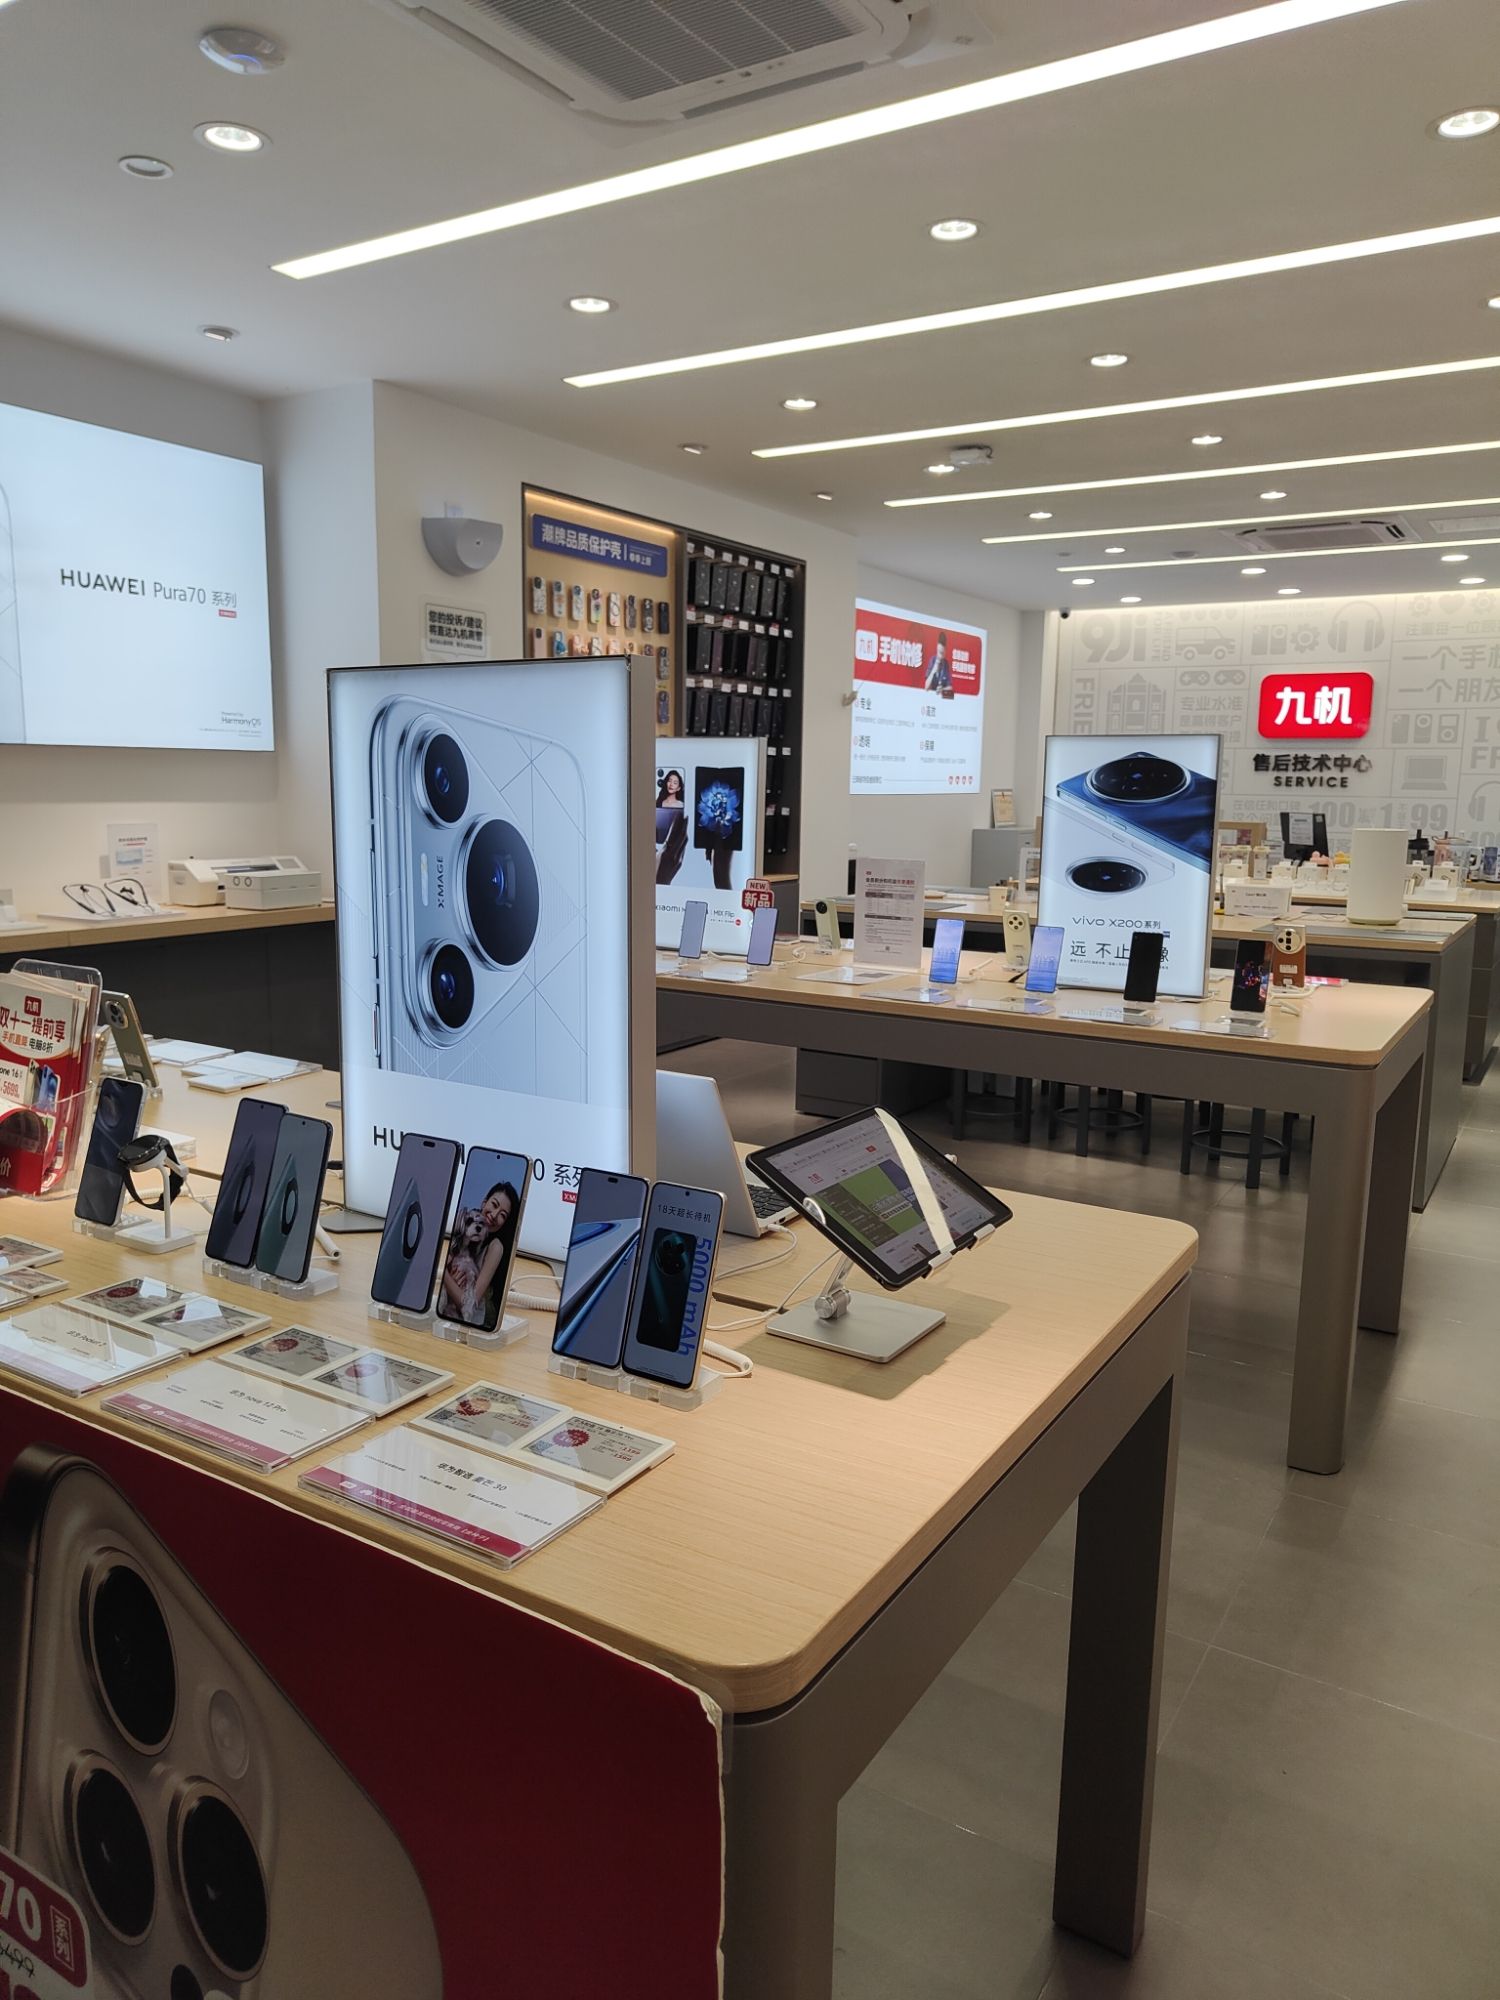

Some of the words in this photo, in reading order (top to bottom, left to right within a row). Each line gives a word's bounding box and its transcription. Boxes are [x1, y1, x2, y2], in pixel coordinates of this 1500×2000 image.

[60, 568, 146, 596] HUAWEI
[153, 581, 207, 605] Pura70
[211, 591, 237, 608] 系列
[1273, 685, 1353, 726] 九机
[221, 716, 262, 728] HarmonyOS
[1252, 753, 1373, 774] 售后技术中心
[1273, 775, 1349, 788] SERVICE
[436, 856, 445, 908] XMAGE
[750, 882, 766, 890] NEW
[744, 891, 770, 908] 新品
[1072, 915, 1105, 926] vivo
[0, 1006, 66, 1042] 双十一提前享
[29, 1037, 54, 1053] 电脑8折
[657, 1204, 712, 1224] 18天超长待机
[688, 1236, 713, 1293] 5000
[677, 1302, 698, 1356] mAh
[0, 1869, 42, 1942] 70
[54, 1914, 70, 1962] 系列
